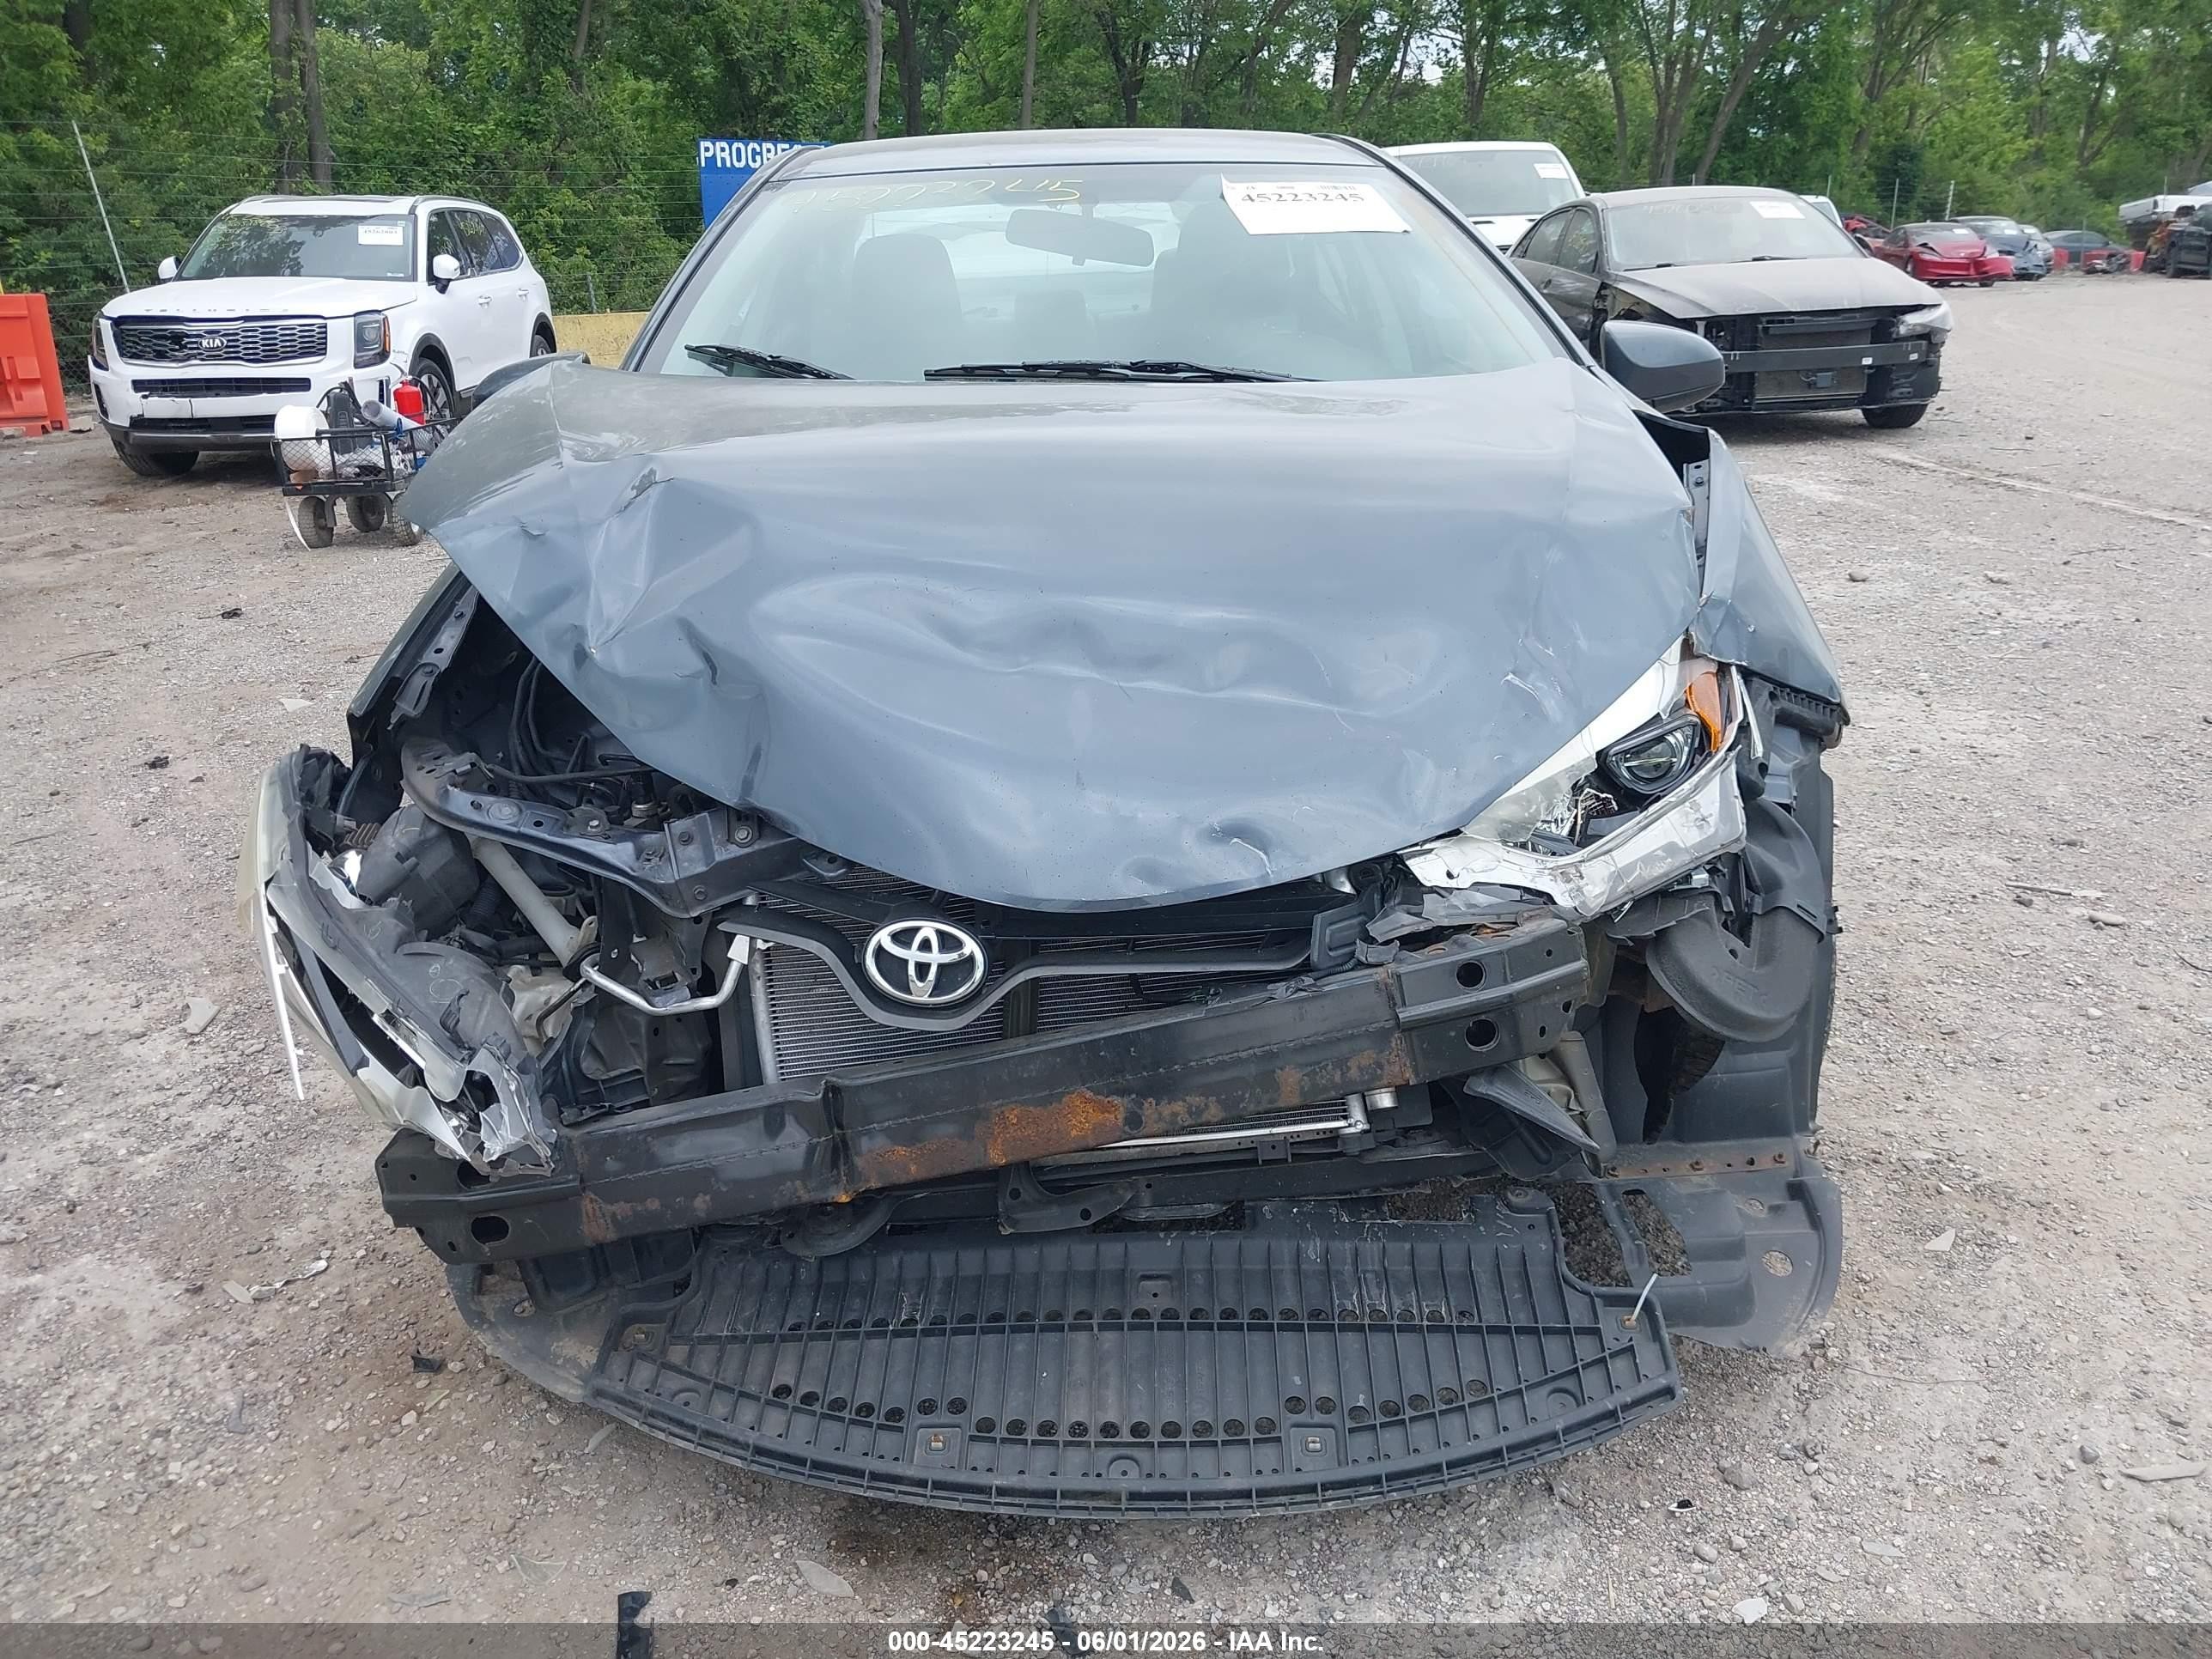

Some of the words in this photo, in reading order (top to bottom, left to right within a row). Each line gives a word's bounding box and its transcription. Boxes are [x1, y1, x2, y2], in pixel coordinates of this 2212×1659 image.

[699, 140, 802, 169] PROGR
[1241, 192, 1365, 203] 45223245
[201, 338, 223, 349] KIA
